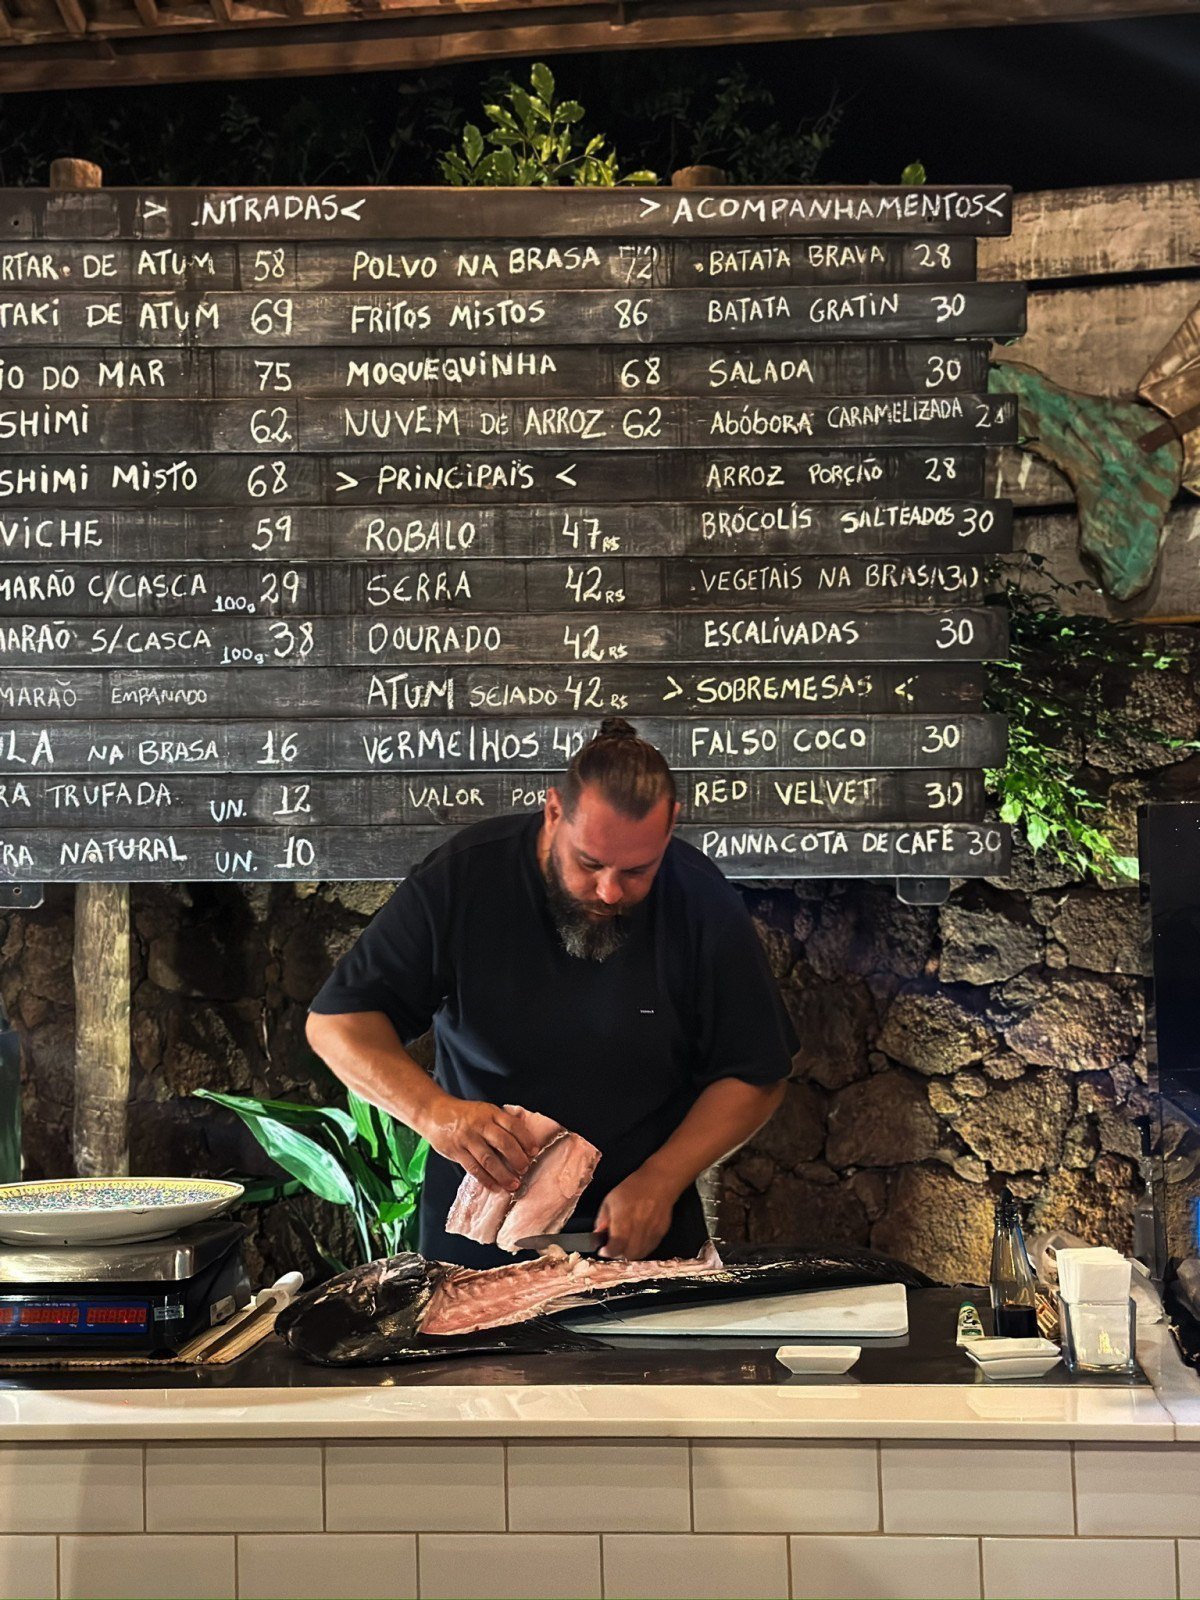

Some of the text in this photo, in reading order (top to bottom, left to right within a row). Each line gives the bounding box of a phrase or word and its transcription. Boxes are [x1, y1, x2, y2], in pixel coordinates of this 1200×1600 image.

[191, 195, 338, 226] NTRADAS
[672, 192, 984, 224] ACOMPANHAMENTOS
[83, 253, 117, 278] DE
[138, 249, 216, 276] ATUM
[254, 248, 285, 282] 58
[353, 251, 438, 281] POLVO
[457, 254, 498, 278] NA
[509, 246, 601, 274] BRASA
[709, 243, 951, 275] BATATA BRAVA 28
[86, 302, 122, 328] DE
[139, 301, 219, 330] ATUM
[251, 298, 293, 335] 69
[351, 298, 652, 333] FRITOS MISTOS 86
[708, 292, 966, 323] BATATA GRATIN 30
[43, 365, 80, 391] DO
[99, 359, 165, 389] MAR
[254, 360, 293, 391] 75
[346, 351, 661, 388] MOQUEQUINHA 68
[709, 356, 961, 388] SALADA 30
[250, 407, 292, 443] 62
[345, 406, 662, 439] NUVEM DE ARROZ 62
[112, 461, 198, 492] MISTO
[248, 461, 288, 497] 68
[706, 464, 785, 489] ARROZ
[924, 457, 957, 482] 28
[252, 515, 292, 551] 59
[366, 518, 476, 553] ROBALO
[562, 513, 602, 549] 47
[840, 505, 955, 533] SALTEADOS
[957, 508, 994, 537] 30
[88, 570, 208, 604] C/CASCA
[260, 571, 299, 603] 29
[367, 570, 472, 606] SERRA
[565, 565, 602, 602] 42
[700, 563, 980, 592] VEGETAIS NA BRASA 30
[91, 624, 212, 654] S/CASCA
[268, 621, 314, 659] 38
[368, 623, 501, 654] DOURADO
[564, 625, 605, 661] 42
[704, 617, 975, 649] ESCALIVADAS 30
[368, 672, 454, 710] ATUM
[565, 675, 605, 711] 42
[697, 674, 873, 703] SOBREMESAS
[88, 745, 125, 765] NA
[139, 740, 219, 765] BRASA
[257, 729, 299, 765] 16
[692, 725, 960, 757] FALSO COCO 30
[48, 782, 172, 808] TRUFADA
[273, 784, 311, 816] 12
[408, 785, 548, 808] VALOR POR
[694, 777, 964, 809] RED VELVET 30
[0, 839, 34, 866] RA
[60, 836, 188, 866] NATURAL
[274, 836, 315, 868] 10
[701, 823, 1002, 857] PANNACOTA DE CAFÉ 30
